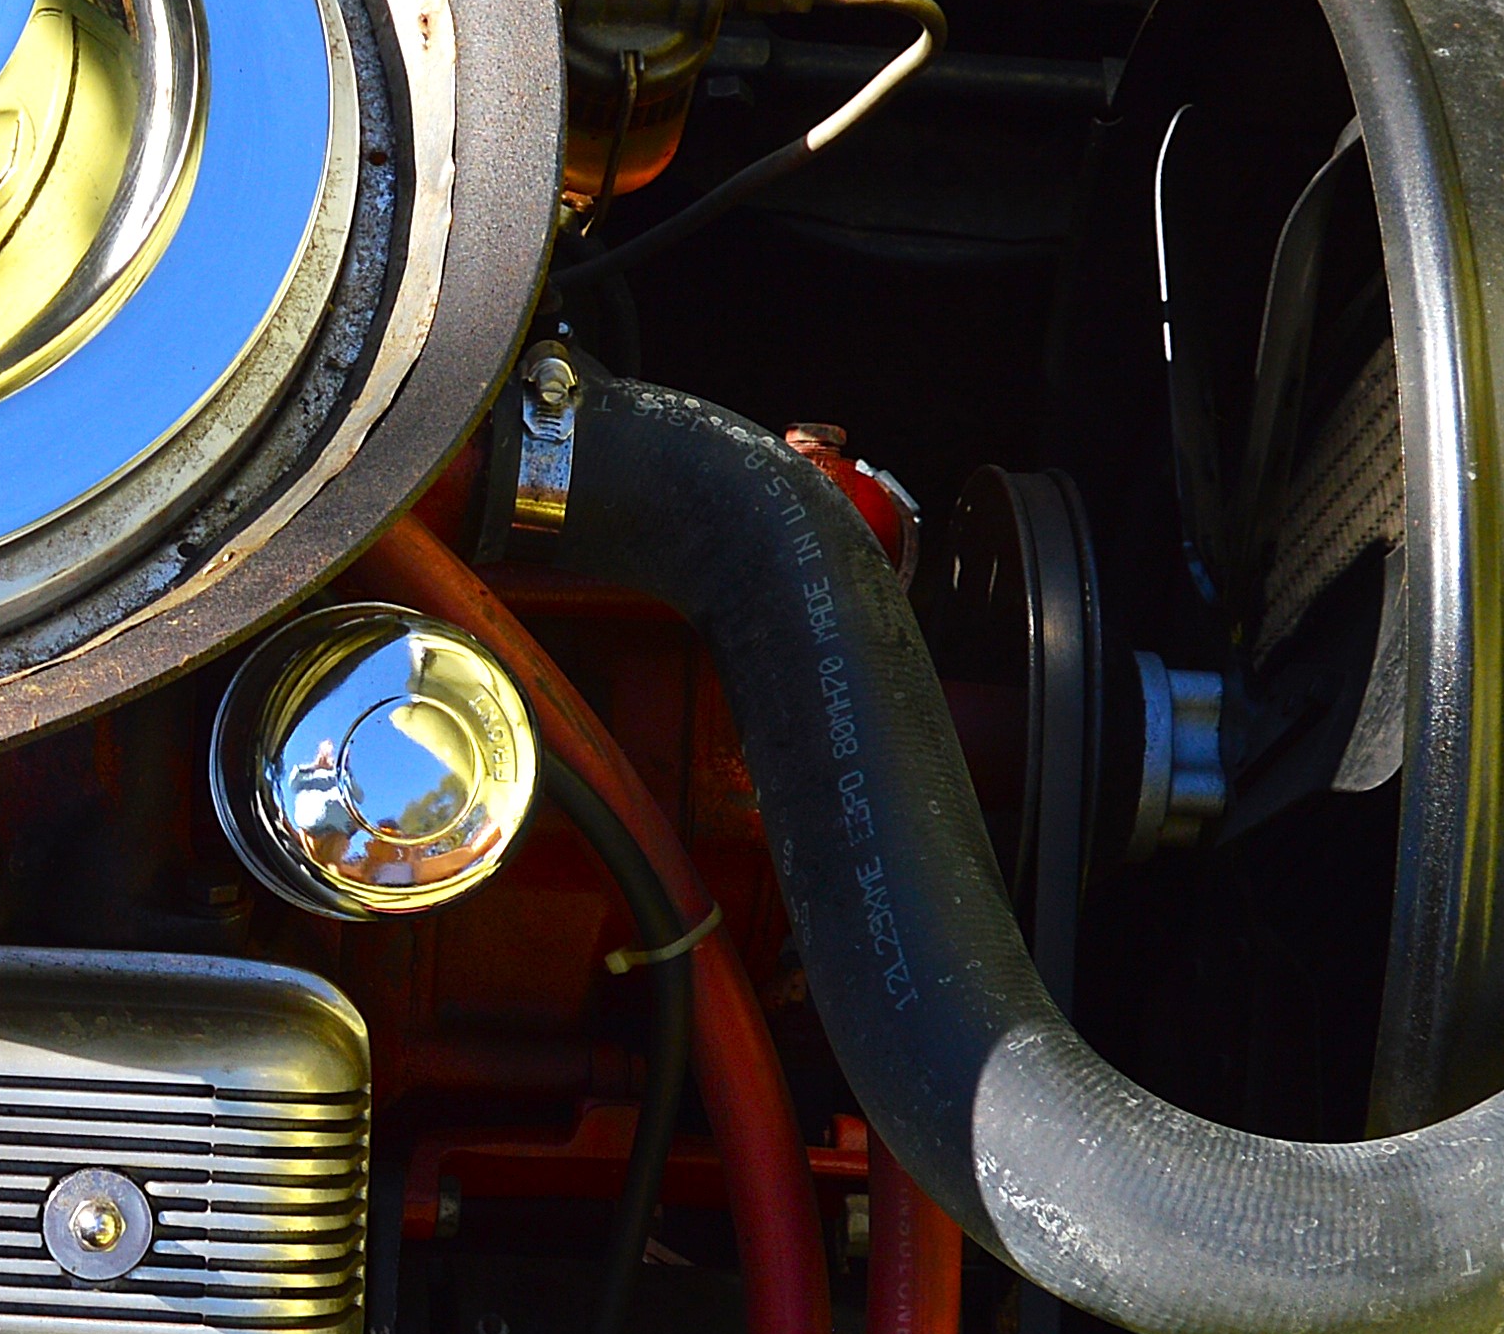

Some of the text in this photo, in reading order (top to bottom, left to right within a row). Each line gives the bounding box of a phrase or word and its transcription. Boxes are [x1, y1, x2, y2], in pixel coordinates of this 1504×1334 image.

[794, 530, 823, 566] IN
[802, 576, 840, 643] MADE
[467, 694, 510, 782] FRONT
